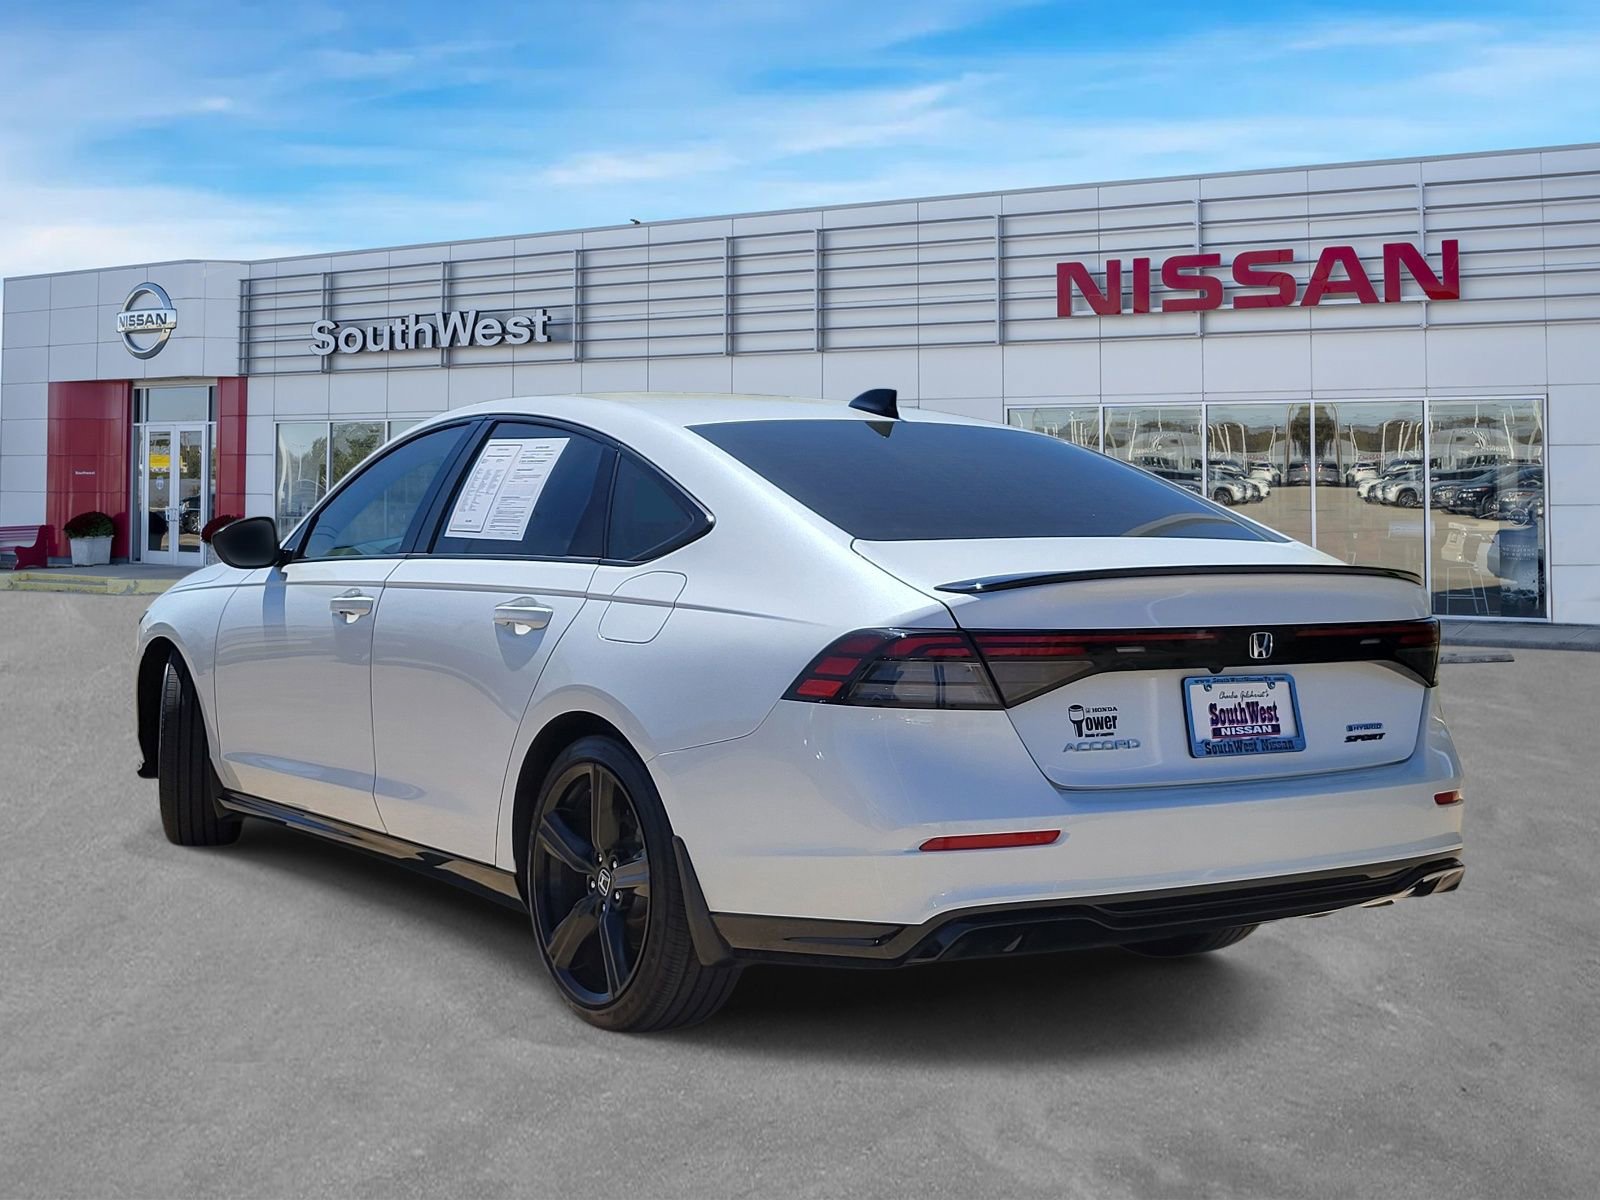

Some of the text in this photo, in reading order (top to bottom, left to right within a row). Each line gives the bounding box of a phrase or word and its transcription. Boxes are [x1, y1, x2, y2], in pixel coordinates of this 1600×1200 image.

[1056, 239, 1461, 318] NISSAN
[117, 312, 168, 330] NISSAN
[309, 308, 552, 356] SouthWest
[1208, 699, 1279, 727] SouthWest
[1220, 724, 1273, 736] NISSAN
[1344, 732, 1386, 743] SPORT
[1062, 738, 1141, 753] ACCORD
[1204, 738, 1294, 755] SouthWest Nissan
